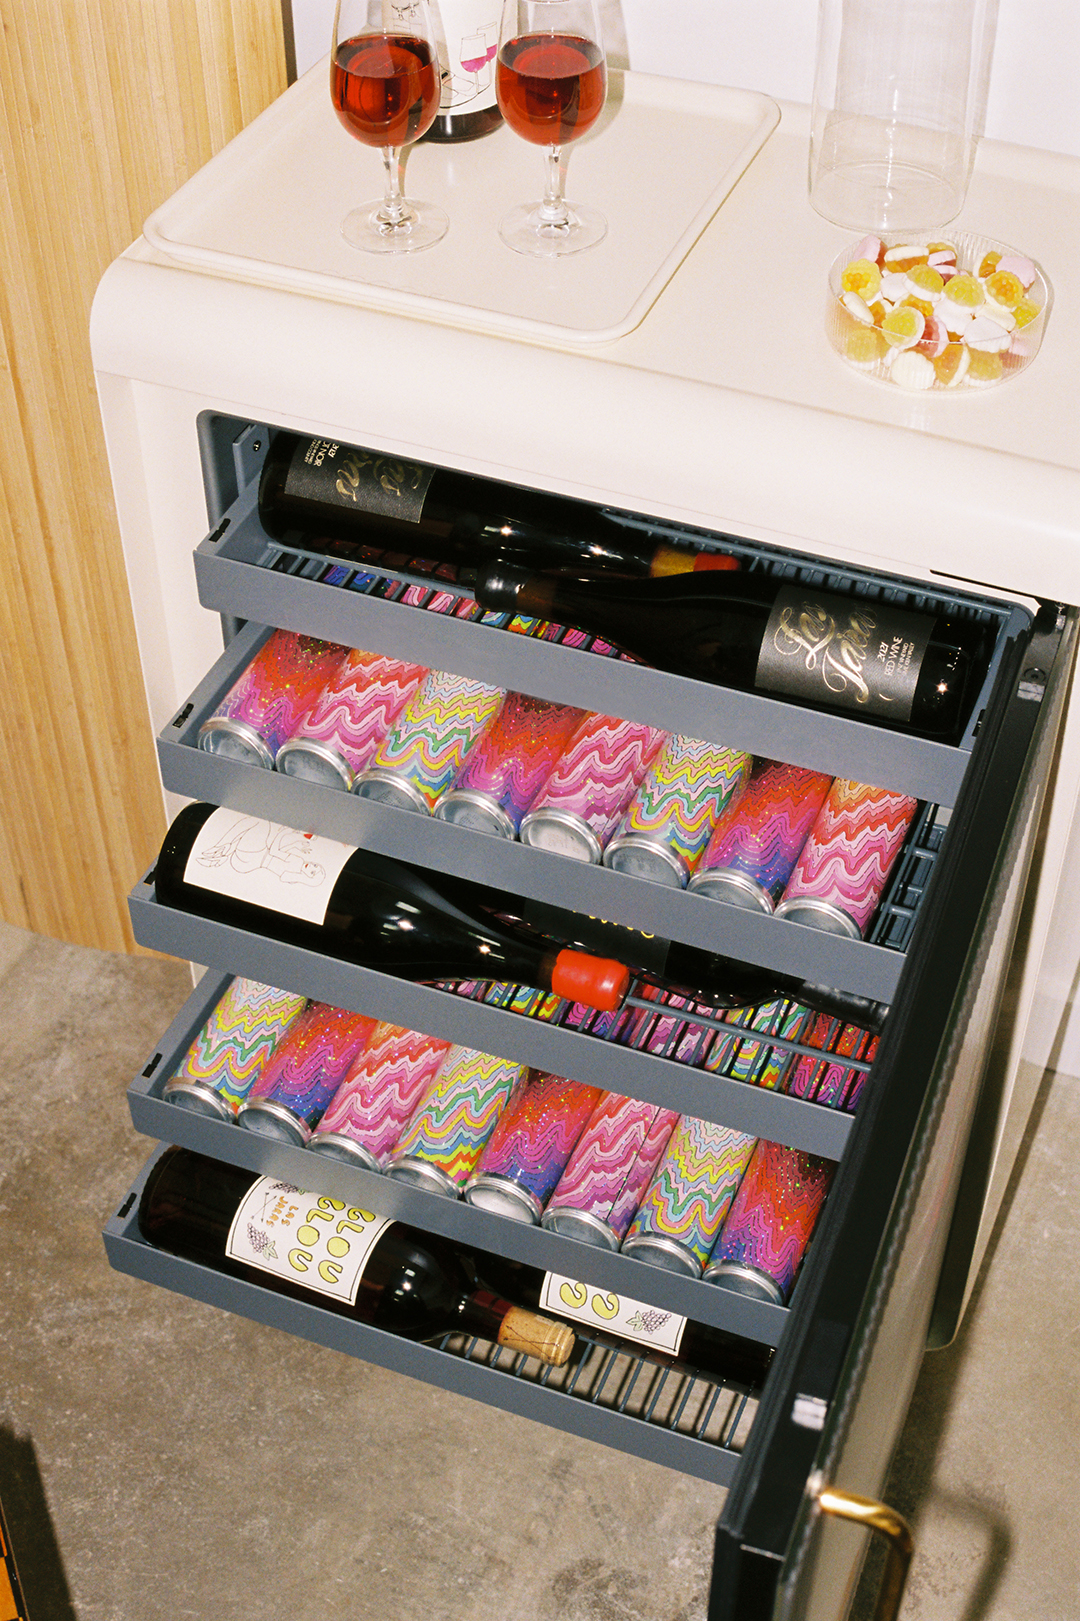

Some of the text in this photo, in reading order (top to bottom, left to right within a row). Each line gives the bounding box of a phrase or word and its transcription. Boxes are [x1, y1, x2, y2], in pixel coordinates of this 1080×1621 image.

[773, 601, 836, 670] Las
[887, 636, 903, 660] WINE
[876, 641, 889, 662] 2021
[884, 658, 897, 676] RED
[266, 1196, 289, 1228] JARAS
[281, 1205, 299, 1226] LAS
[288, 1196, 346, 1273] GLOU
[317, 1207, 376, 1284] GLOU
